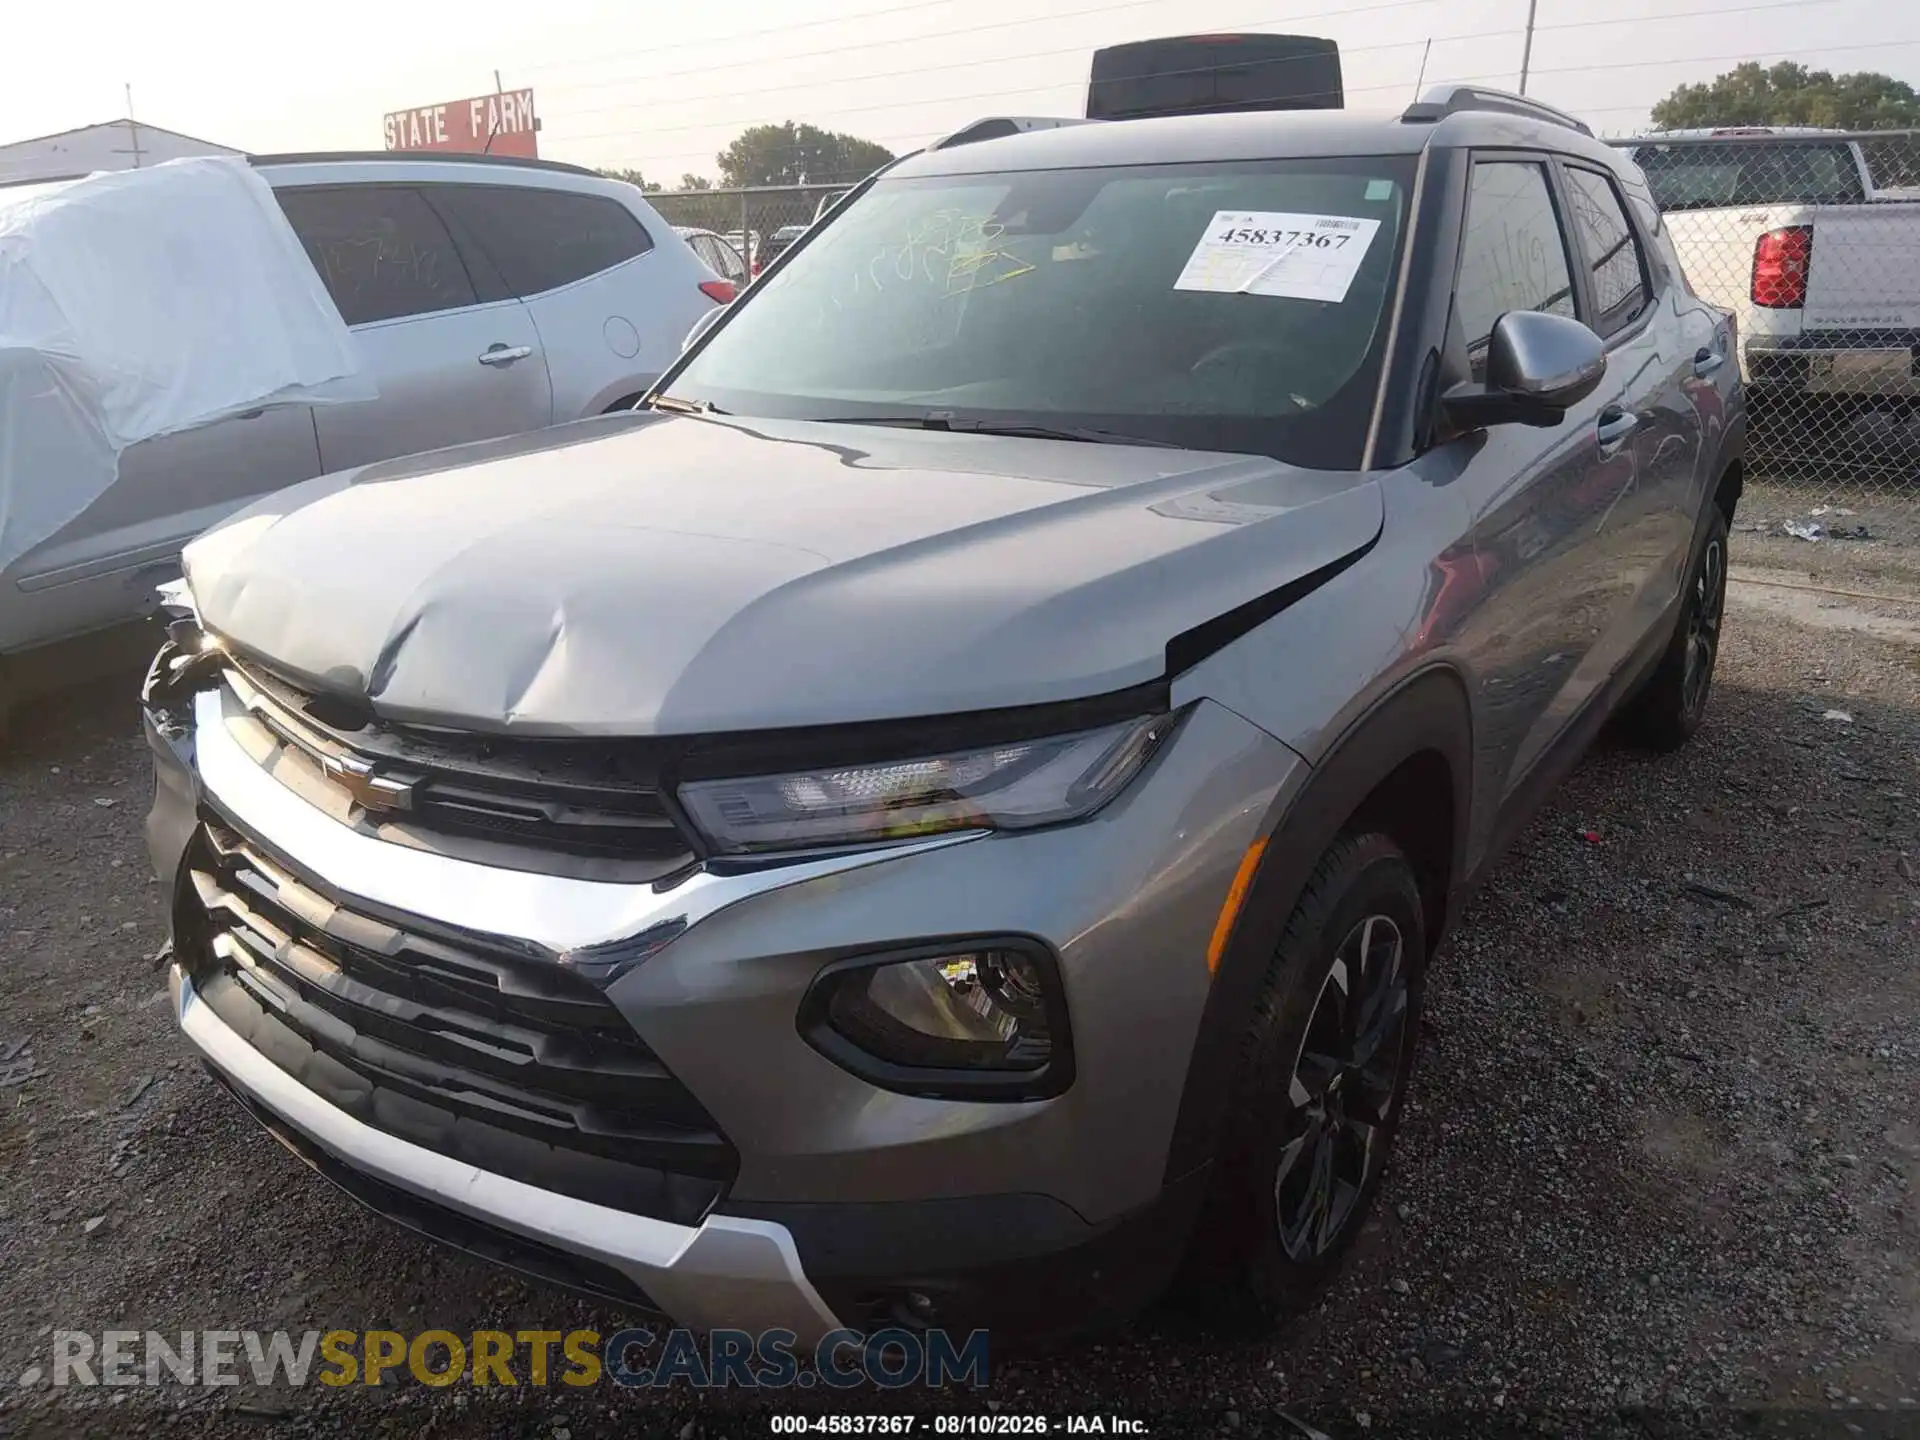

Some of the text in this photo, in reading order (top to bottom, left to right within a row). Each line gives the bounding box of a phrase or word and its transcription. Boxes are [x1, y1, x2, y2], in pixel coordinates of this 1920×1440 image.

[384, 90, 534, 150] STATE FARM
[1218, 228, 1351, 250] 45837367
